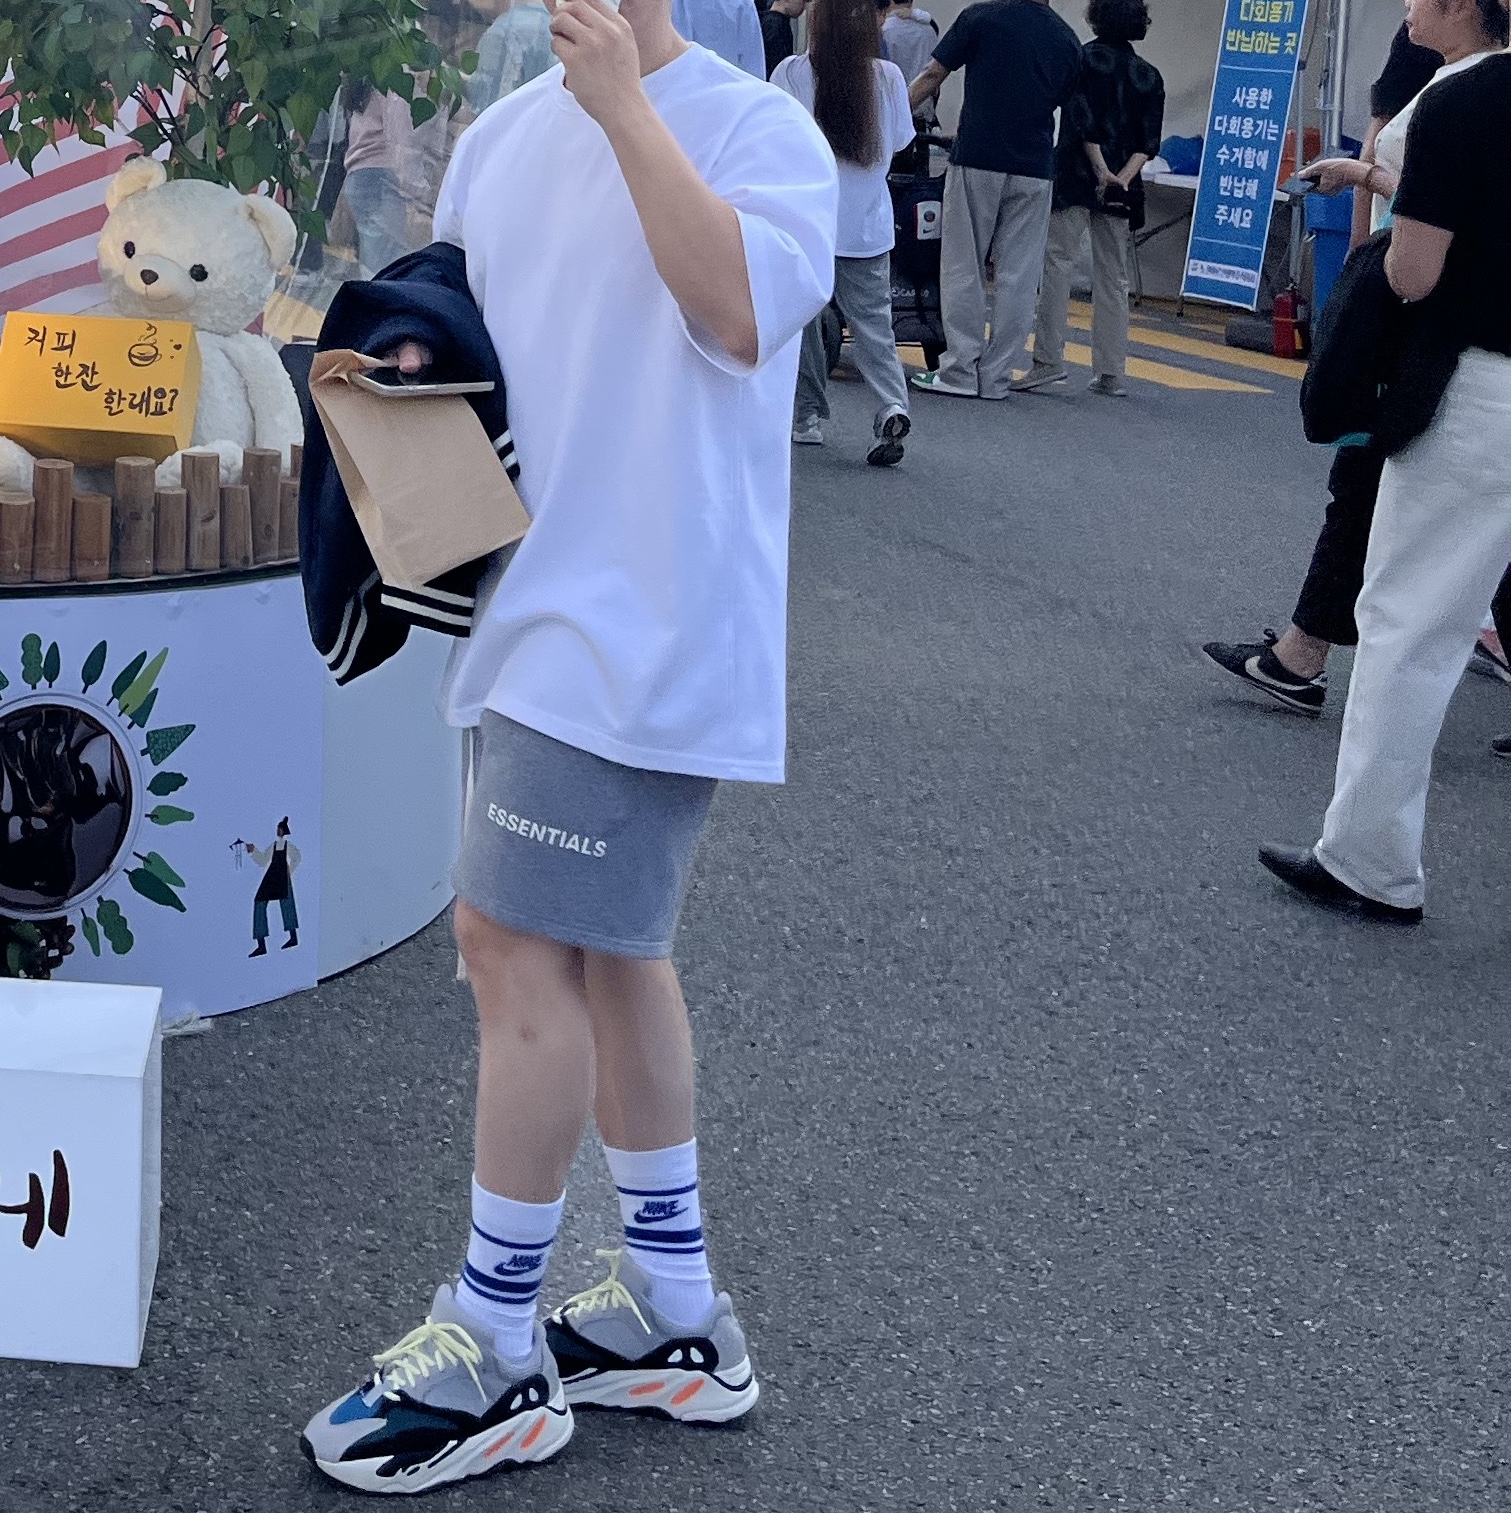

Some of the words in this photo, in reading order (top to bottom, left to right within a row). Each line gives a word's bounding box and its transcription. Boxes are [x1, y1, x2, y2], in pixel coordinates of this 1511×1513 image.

[1226, 28, 1281, 54] 반납하는
[1284, 32, 1297, 55] 곳
[1232, 86, 1273, 110] 사용한
[1214, 114, 1280, 141] 다회용기는
[1216, 144, 1270, 171] 수거함에
[1219, 174, 1259, 200] 반납해
[1214, 204, 1254, 229] 주세요
[24, 325, 77, 358] 커피
[51, 361, 103, 392] 한잔
[487, 802, 608, 858] ESSENTIALS
[641, 1199, 679, 1215] NIKE
